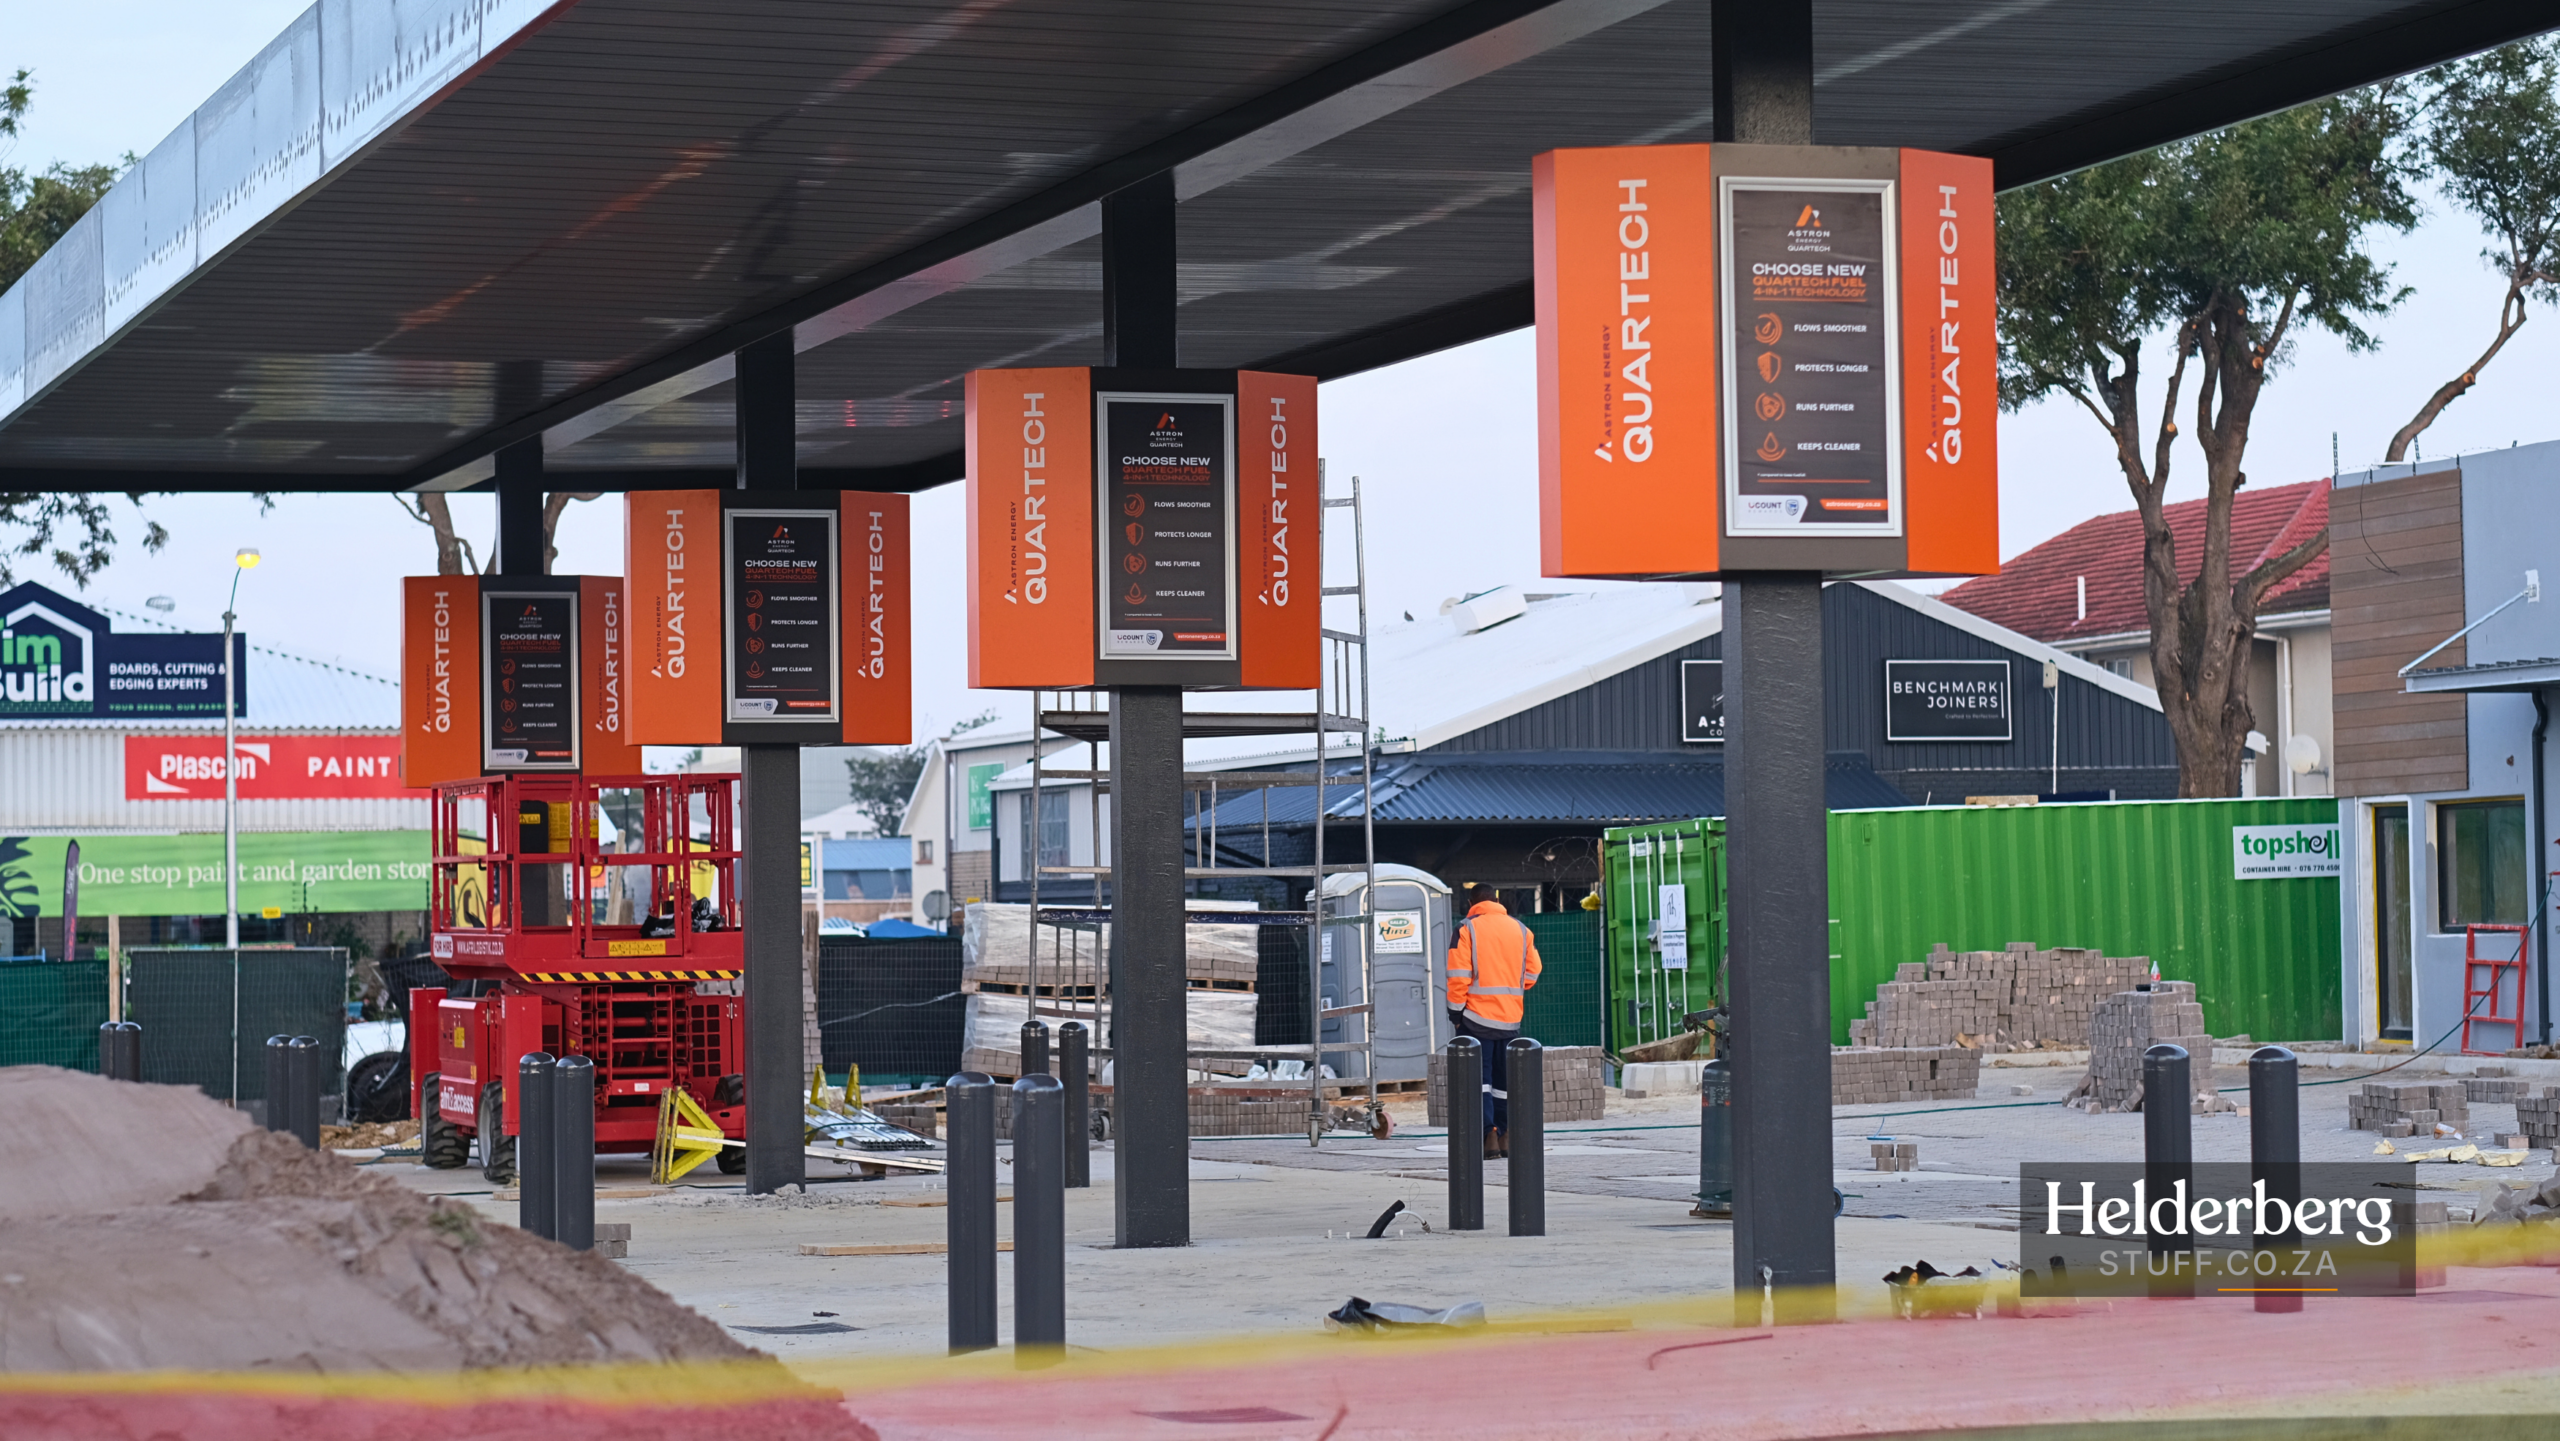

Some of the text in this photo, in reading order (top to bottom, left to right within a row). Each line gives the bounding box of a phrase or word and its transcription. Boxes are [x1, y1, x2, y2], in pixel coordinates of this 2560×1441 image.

[1752, 263, 1866, 276] CHOOSE NEW
[1752, 276, 1866, 287] QUARTECH FUEL
[1753, 288, 1866, 297] 4-IN-1 TECHNOLOGY
[1618, 179, 1653, 462] QUARTECH
[1939, 185, 1962, 464] QUARTECH
[1602, 324, 1612, 438] ASTRON ENERGY
[1123, 456, 1210, 465] CHOOSE NEW
[1024, 392, 1047, 604] QUARTECH
[1270, 397, 1288, 606] QUARTECH
[666, 509, 685, 678] QUARTECH
[869, 512, 884, 679] QUARTECH
[0, 618, 61, 665] im
[109, 663, 226, 676] BOARDS, CUTTING &
[434, 591, 450, 732] QUARTECH
[605, 592, 618, 732] QUARTECH
[110, 678, 208, 690] EDGING EXPERTS
[1893, 681, 1998, 694] BENCHMARK
[109, 703, 134, 711] YOUR
[176, 703, 196, 711] OUR
[1927, 696, 1998, 708] JOINERS
[308, 757, 391, 777] PAINT
[2241, 830, 2340, 861] topshell
[78, 862, 124, 884] One
[131, 863, 181, 888] stop
[188, 861, 248, 888] pait
[253, 859, 295, 881] and
[302, 859, 382, 887] garden
[1379, 926, 1411, 935] HIRE
[443, 940, 453, 953] HIRE
